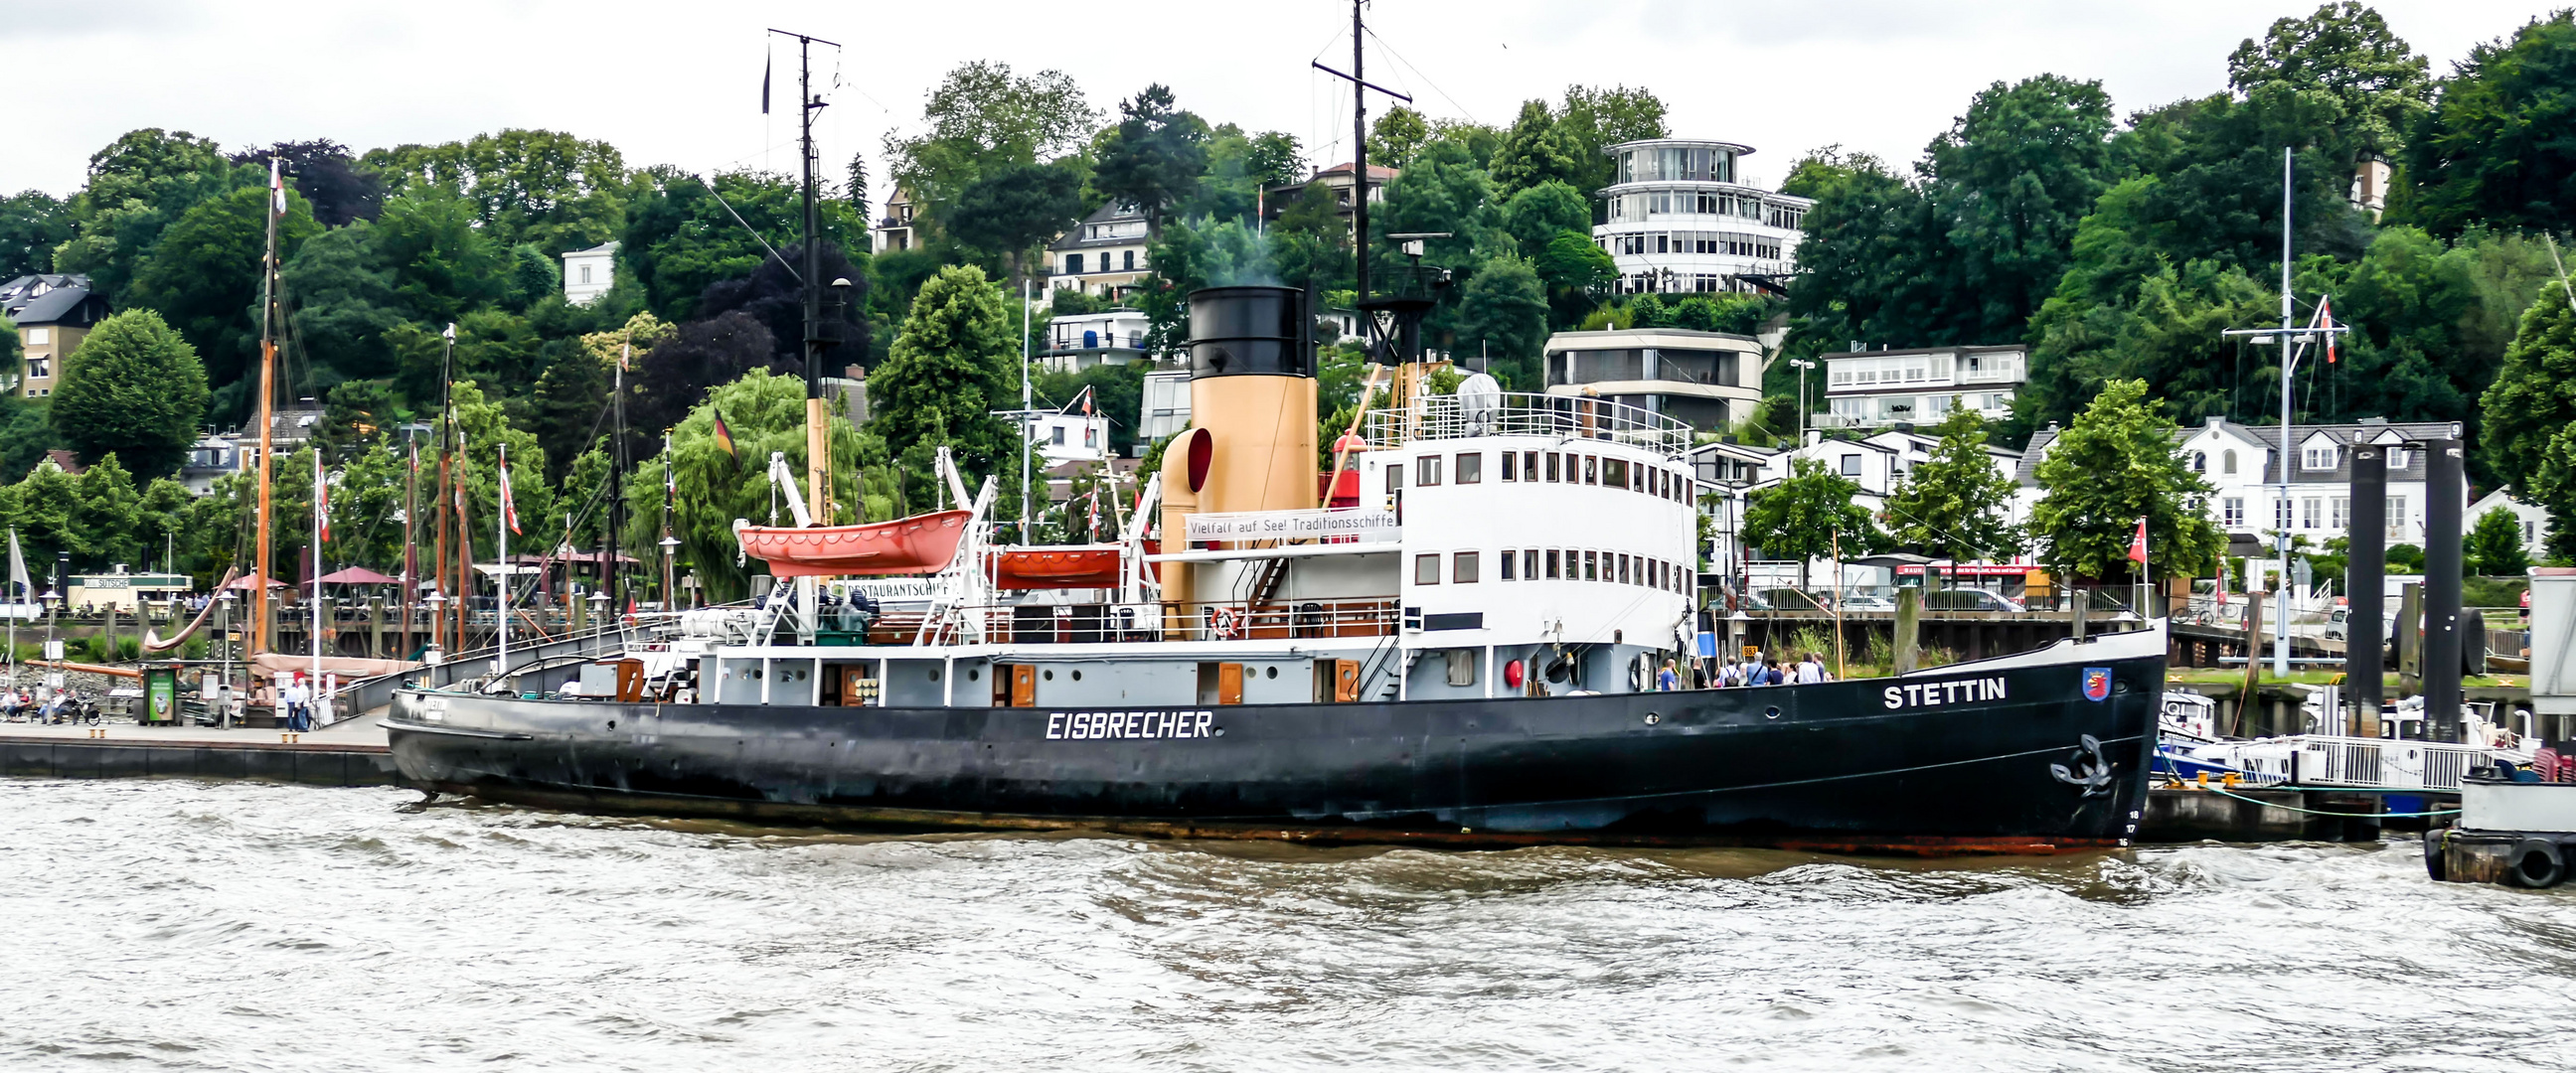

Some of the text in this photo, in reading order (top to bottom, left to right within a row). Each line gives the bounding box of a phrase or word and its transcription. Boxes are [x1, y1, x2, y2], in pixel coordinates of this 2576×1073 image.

[1190, 513, 1393, 535] Vielfalt auf See! Traditionsschiffe
[1743, 647, 1757, 656] 983
[1883, 677, 2007, 709] STETTIN
[1046, 710, 1213, 739] EISBRECHER
[2129, 810, 2140, 820] 18
[2126, 824, 2136, 834] 17
[2118, 838, 2129, 846] 16
